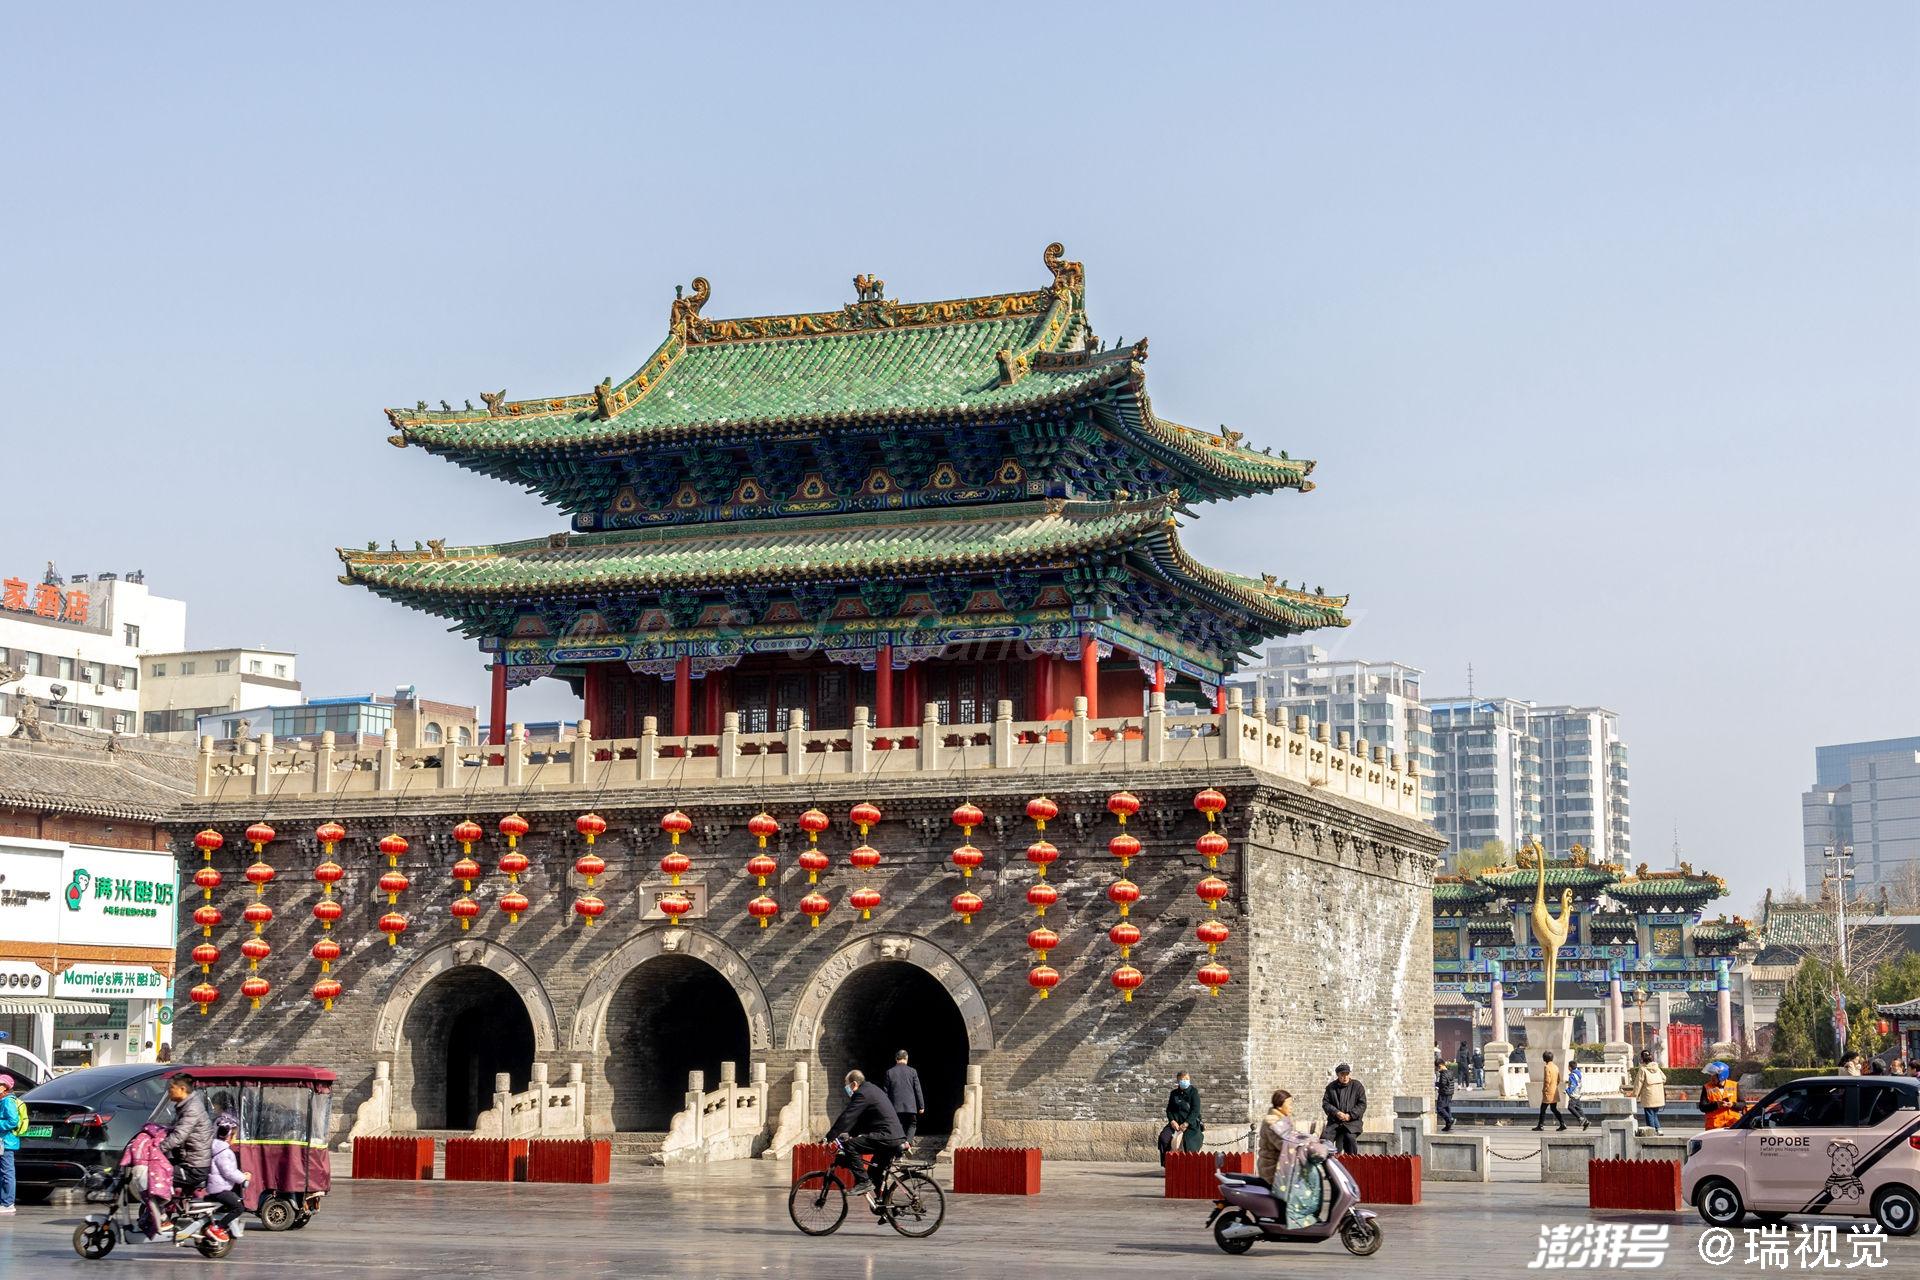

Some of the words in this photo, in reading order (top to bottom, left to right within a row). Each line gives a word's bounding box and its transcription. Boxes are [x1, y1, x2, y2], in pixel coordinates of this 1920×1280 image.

[3, 576, 90, 624] 家酒店
[94, 877, 174, 906] 满米酸奶
[1760, 1137, 1810, 1147] POPOBE
